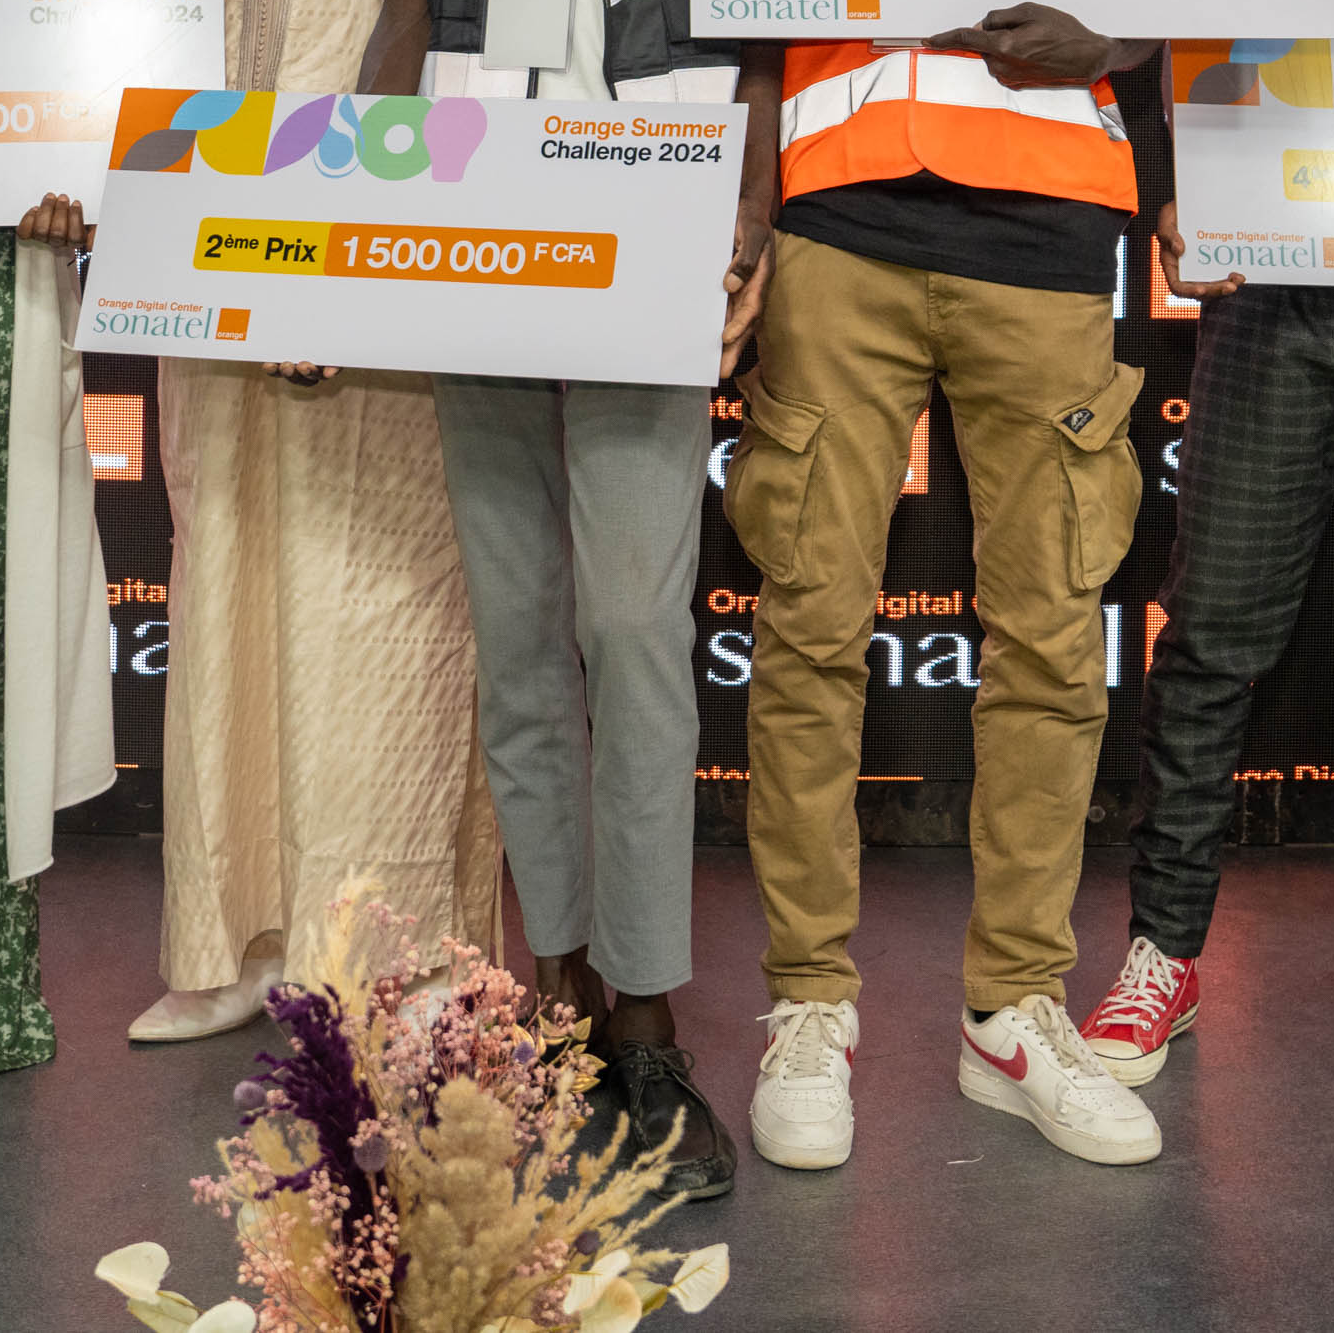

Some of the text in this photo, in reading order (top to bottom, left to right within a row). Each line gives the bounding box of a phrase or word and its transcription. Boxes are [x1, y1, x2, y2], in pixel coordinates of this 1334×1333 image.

[544, 115, 727, 141] Orange Summer
[541, 139, 722, 166] Challenge 2024
[204, 233, 259, 259] 2ème
[265, 237, 317, 263] Prix
[534, 242, 549, 262] F
[551, 244, 596, 264] CFA
[1196, 230, 1305, 243] Orange Digital Center
[1197, 237, 1316, 268] sonatel
[98, 298, 203, 313] Orange Digital Center
[93, 307, 213, 339] sonatel
[217, 331, 244, 340] orange
[876, 590, 963, 620] igital
